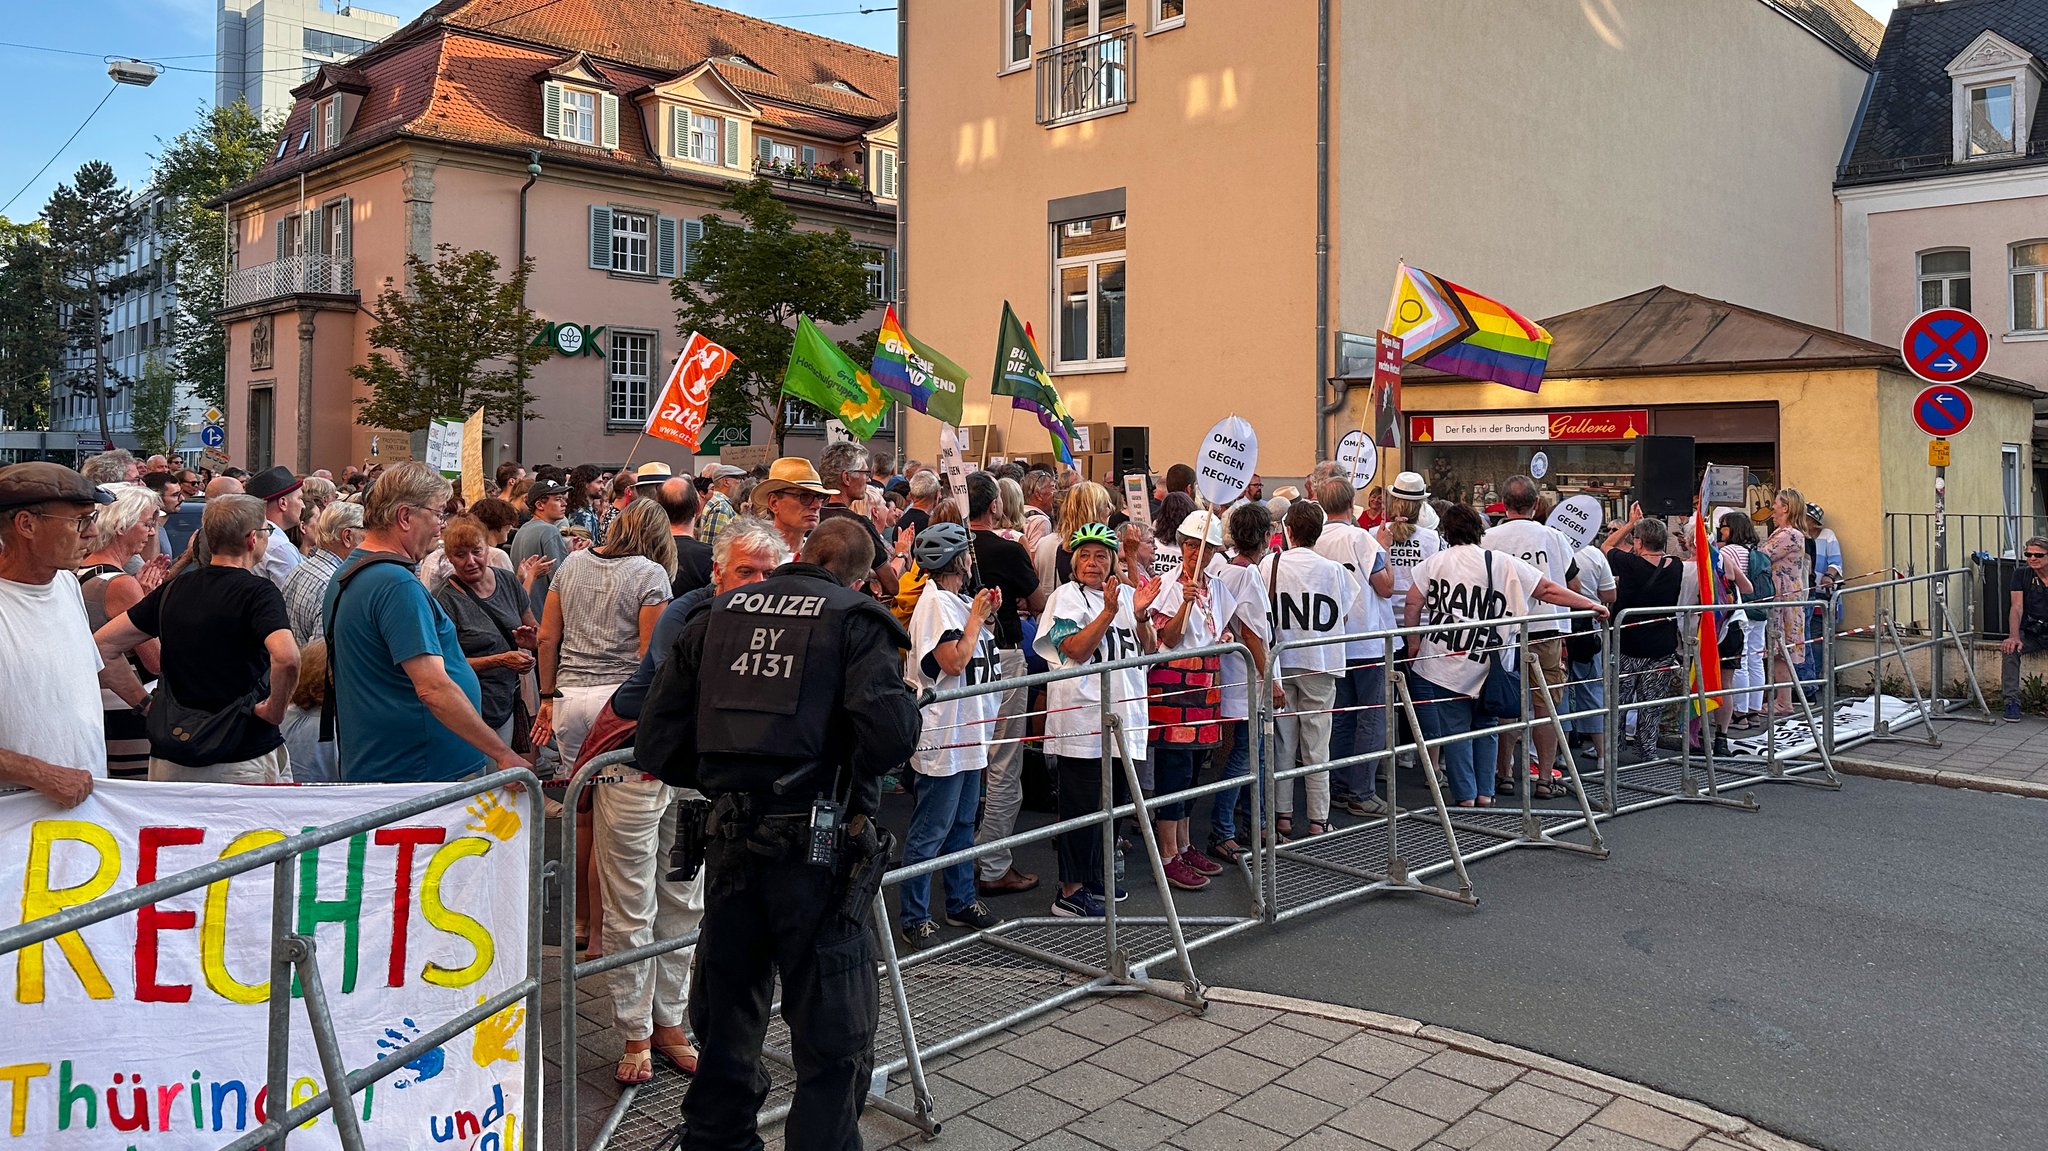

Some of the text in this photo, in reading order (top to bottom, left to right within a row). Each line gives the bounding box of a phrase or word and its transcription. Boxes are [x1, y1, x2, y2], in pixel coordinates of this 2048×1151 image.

[530, 322, 606, 357] AOK
[796, 356, 858, 400] Hochschulgruppe
[1007, 361, 1026, 373] DIE
[713, 427, 748, 441] AOK
[1445, 423, 1546, 435] Der Fels in der Brandung
[1550, 415, 1616, 439] Gallerie
[1213, 433, 1246, 452] OMAS
[1208, 449, 1245, 471] GEGEN
[1201, 466, 1244, 490] RECHTS
[1565, 503, 1589, 521] OPAS
[1557, 514, 1587, 535] GEGEN
[1391, 549, 1421, 557] EGEN
[726, 592, 826, 616] POLIZEI
[750, 627, 785, 651] BY
[731, 652, 794, 678] 4131
[16, 819, 495, 1004] RECHTS
[430, 1083, 505, 1143] und
